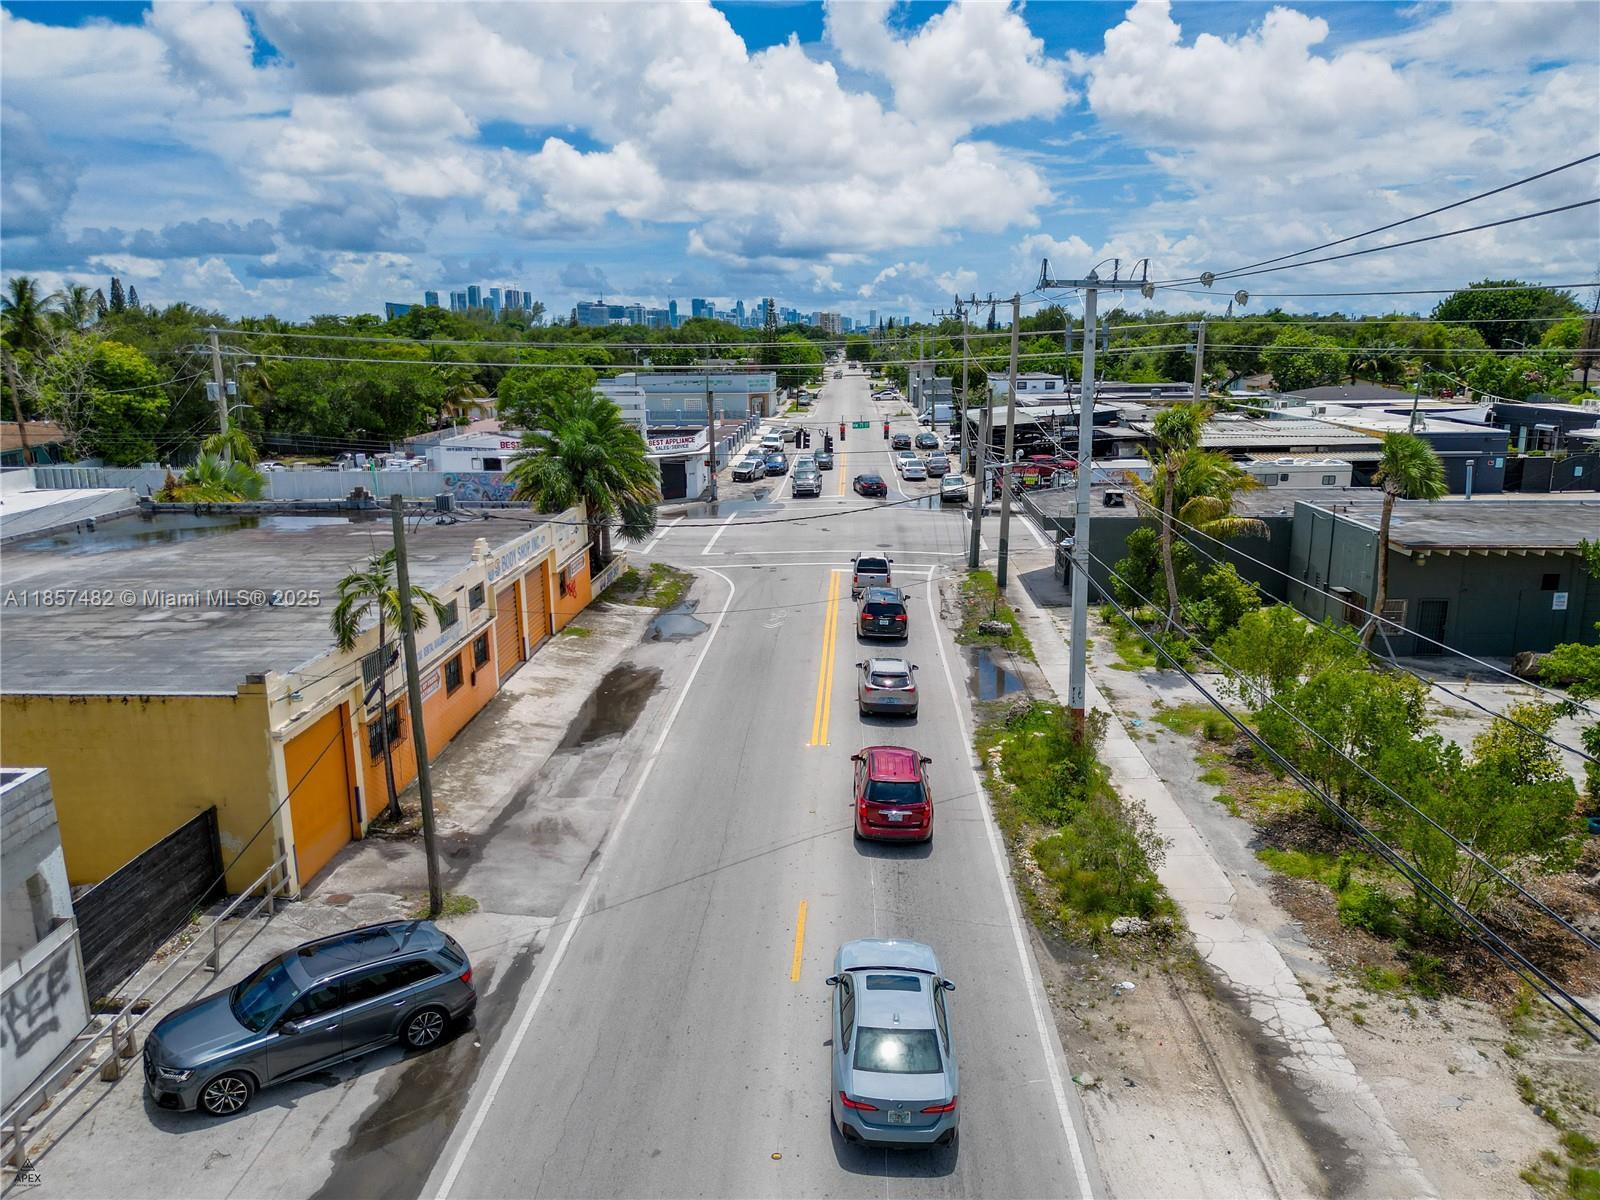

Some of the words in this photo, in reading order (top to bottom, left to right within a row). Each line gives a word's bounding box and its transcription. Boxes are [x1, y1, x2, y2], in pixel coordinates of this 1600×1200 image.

[500, 441, 520, 449] BEST
[665, 436, 696, 445] APPLIANCE
[501, 549, 517, 572] BODY
